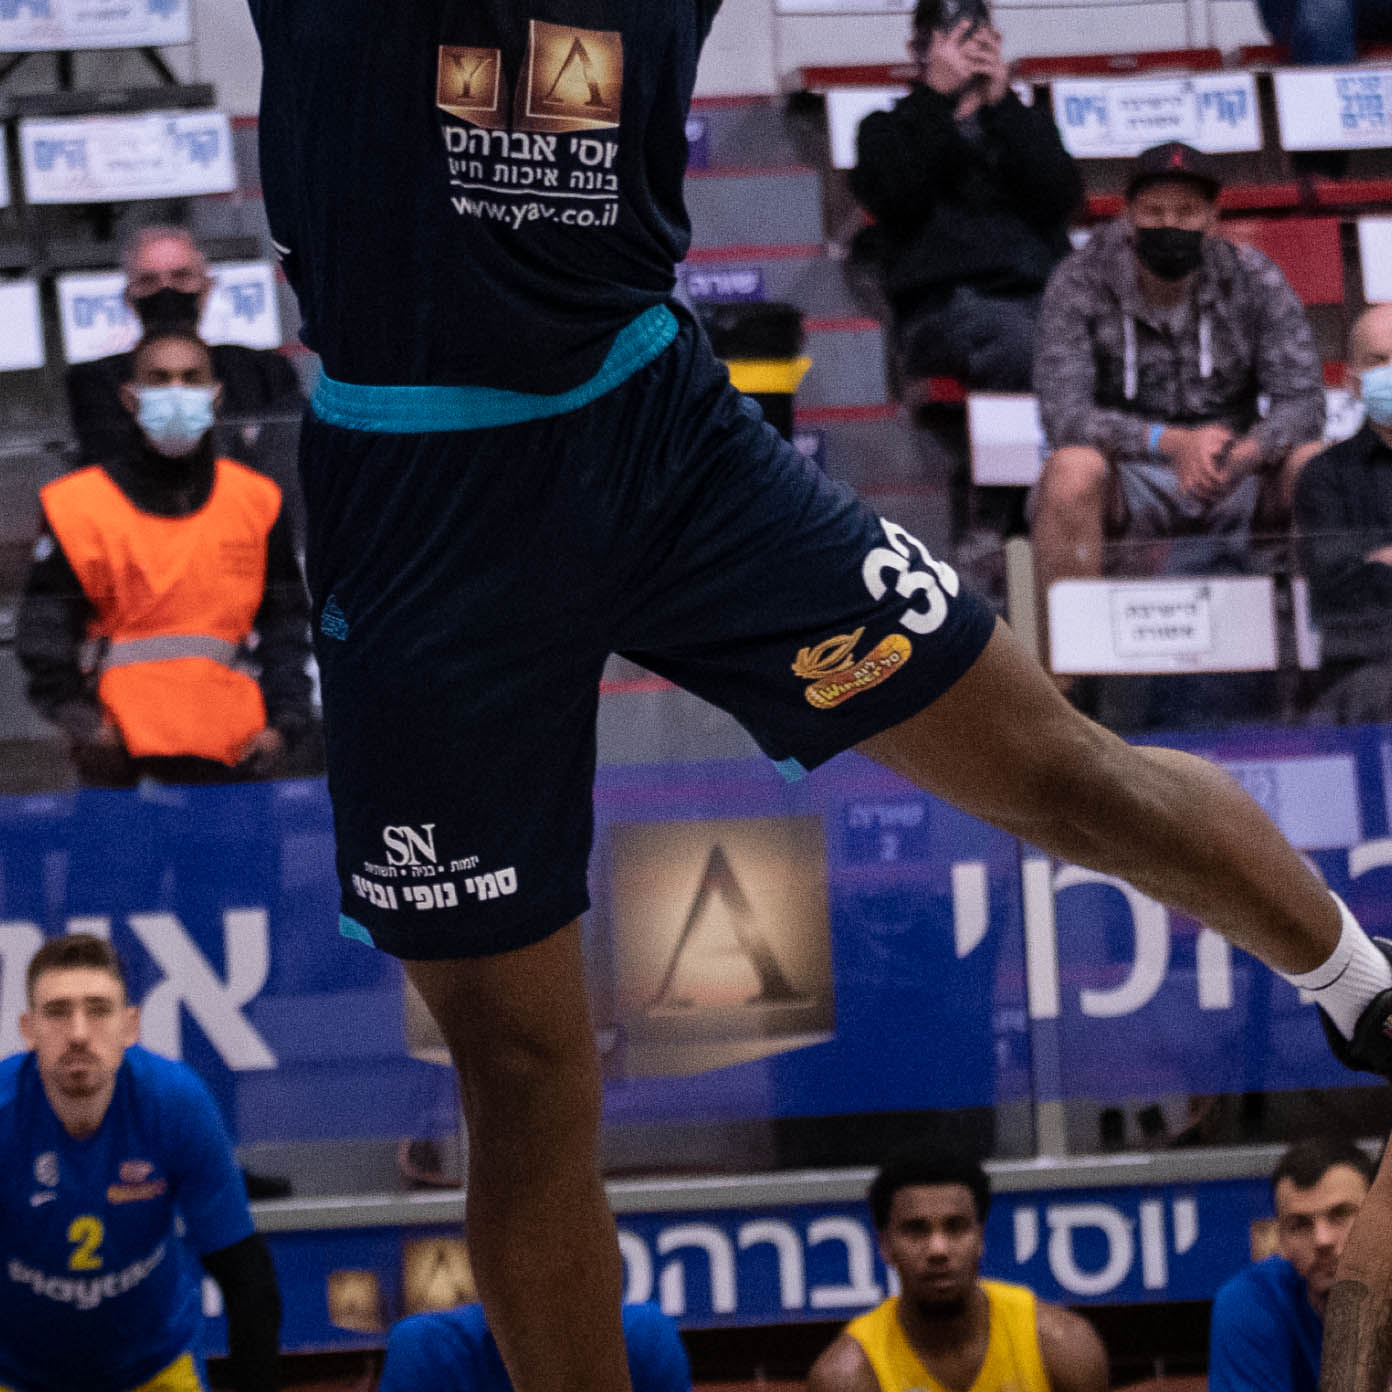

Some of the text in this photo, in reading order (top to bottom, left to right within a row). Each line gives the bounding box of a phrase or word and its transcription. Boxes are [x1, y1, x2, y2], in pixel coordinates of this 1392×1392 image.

[570, 142, 621, 170] יוסי
[492, 165, 559, 188] איכות
[571, 171, 621, 193] בונה
[381, 823, 437, 869] SN
[405, 880, 459, 911] נופי
[466, 866, 518, 902] סמי
[66, 1213, 105, 1272] 2
[1013, 1198, 1200, 1298] יוסי
